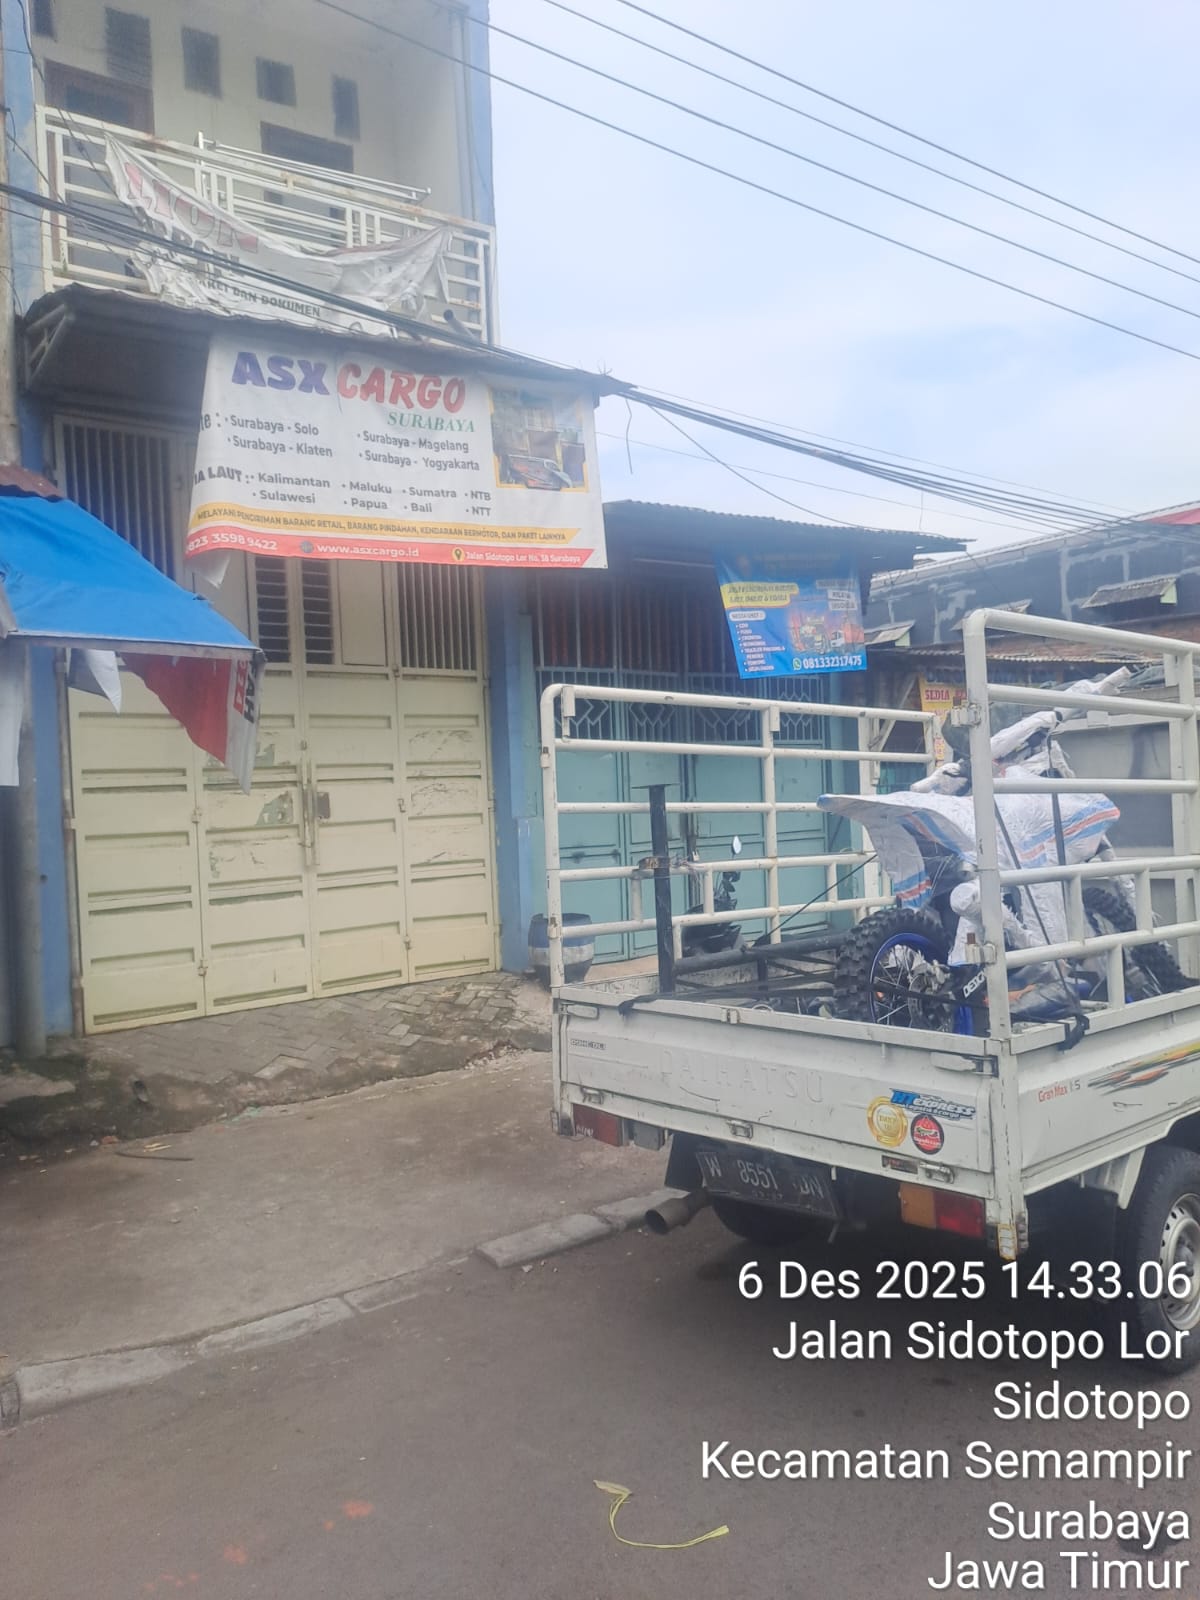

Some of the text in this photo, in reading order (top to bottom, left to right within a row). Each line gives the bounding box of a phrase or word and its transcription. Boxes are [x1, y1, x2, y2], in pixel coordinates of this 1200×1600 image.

[261, 294, 321, 317] DOKUMEN
[231, 351, 466, 414] ASX CARGO
[230, 415, 284, 434] Surabaya
[294, 422, 319, 436] Solo
[387, 412, 476, 433] SURABAYA
[233, 435, 286, 454] Surabaya
[296, 442, 333, 457] Klaten
[363, 430, 410, 448] Surabaya
[418, 438, 469, 454] Magelang
[365, 450, 412, 468] Surabaya
[422, 456, 480, 472] Yogyakarta
[208, 465, 242, 483] LAUT
[258, 472, 331, 489] Kalimantan
[259, 489, 316, 505] Sulawesi
[349, 481, 393, 496] Maluku
[409, 486, 457, 499] Sumatra
[470, 490, 492, 502] NTB
[351, 497, 388, 513] Papua
[411, 502, 433, 514] Bali
[472, 506, 492, 518] NTT
[317, 543, 419, 558] www.asxcargo.id
[803, 655, 862, 669] 081332317475
[925, 688, 950, 700] SEDIA
[1038, 1088, 1055, 1102] Gran
[1055, 1084, 1068, 1098] Max
[704, 1155, 722, 1177] W
[737, 1159, 778, 1190] 8551
